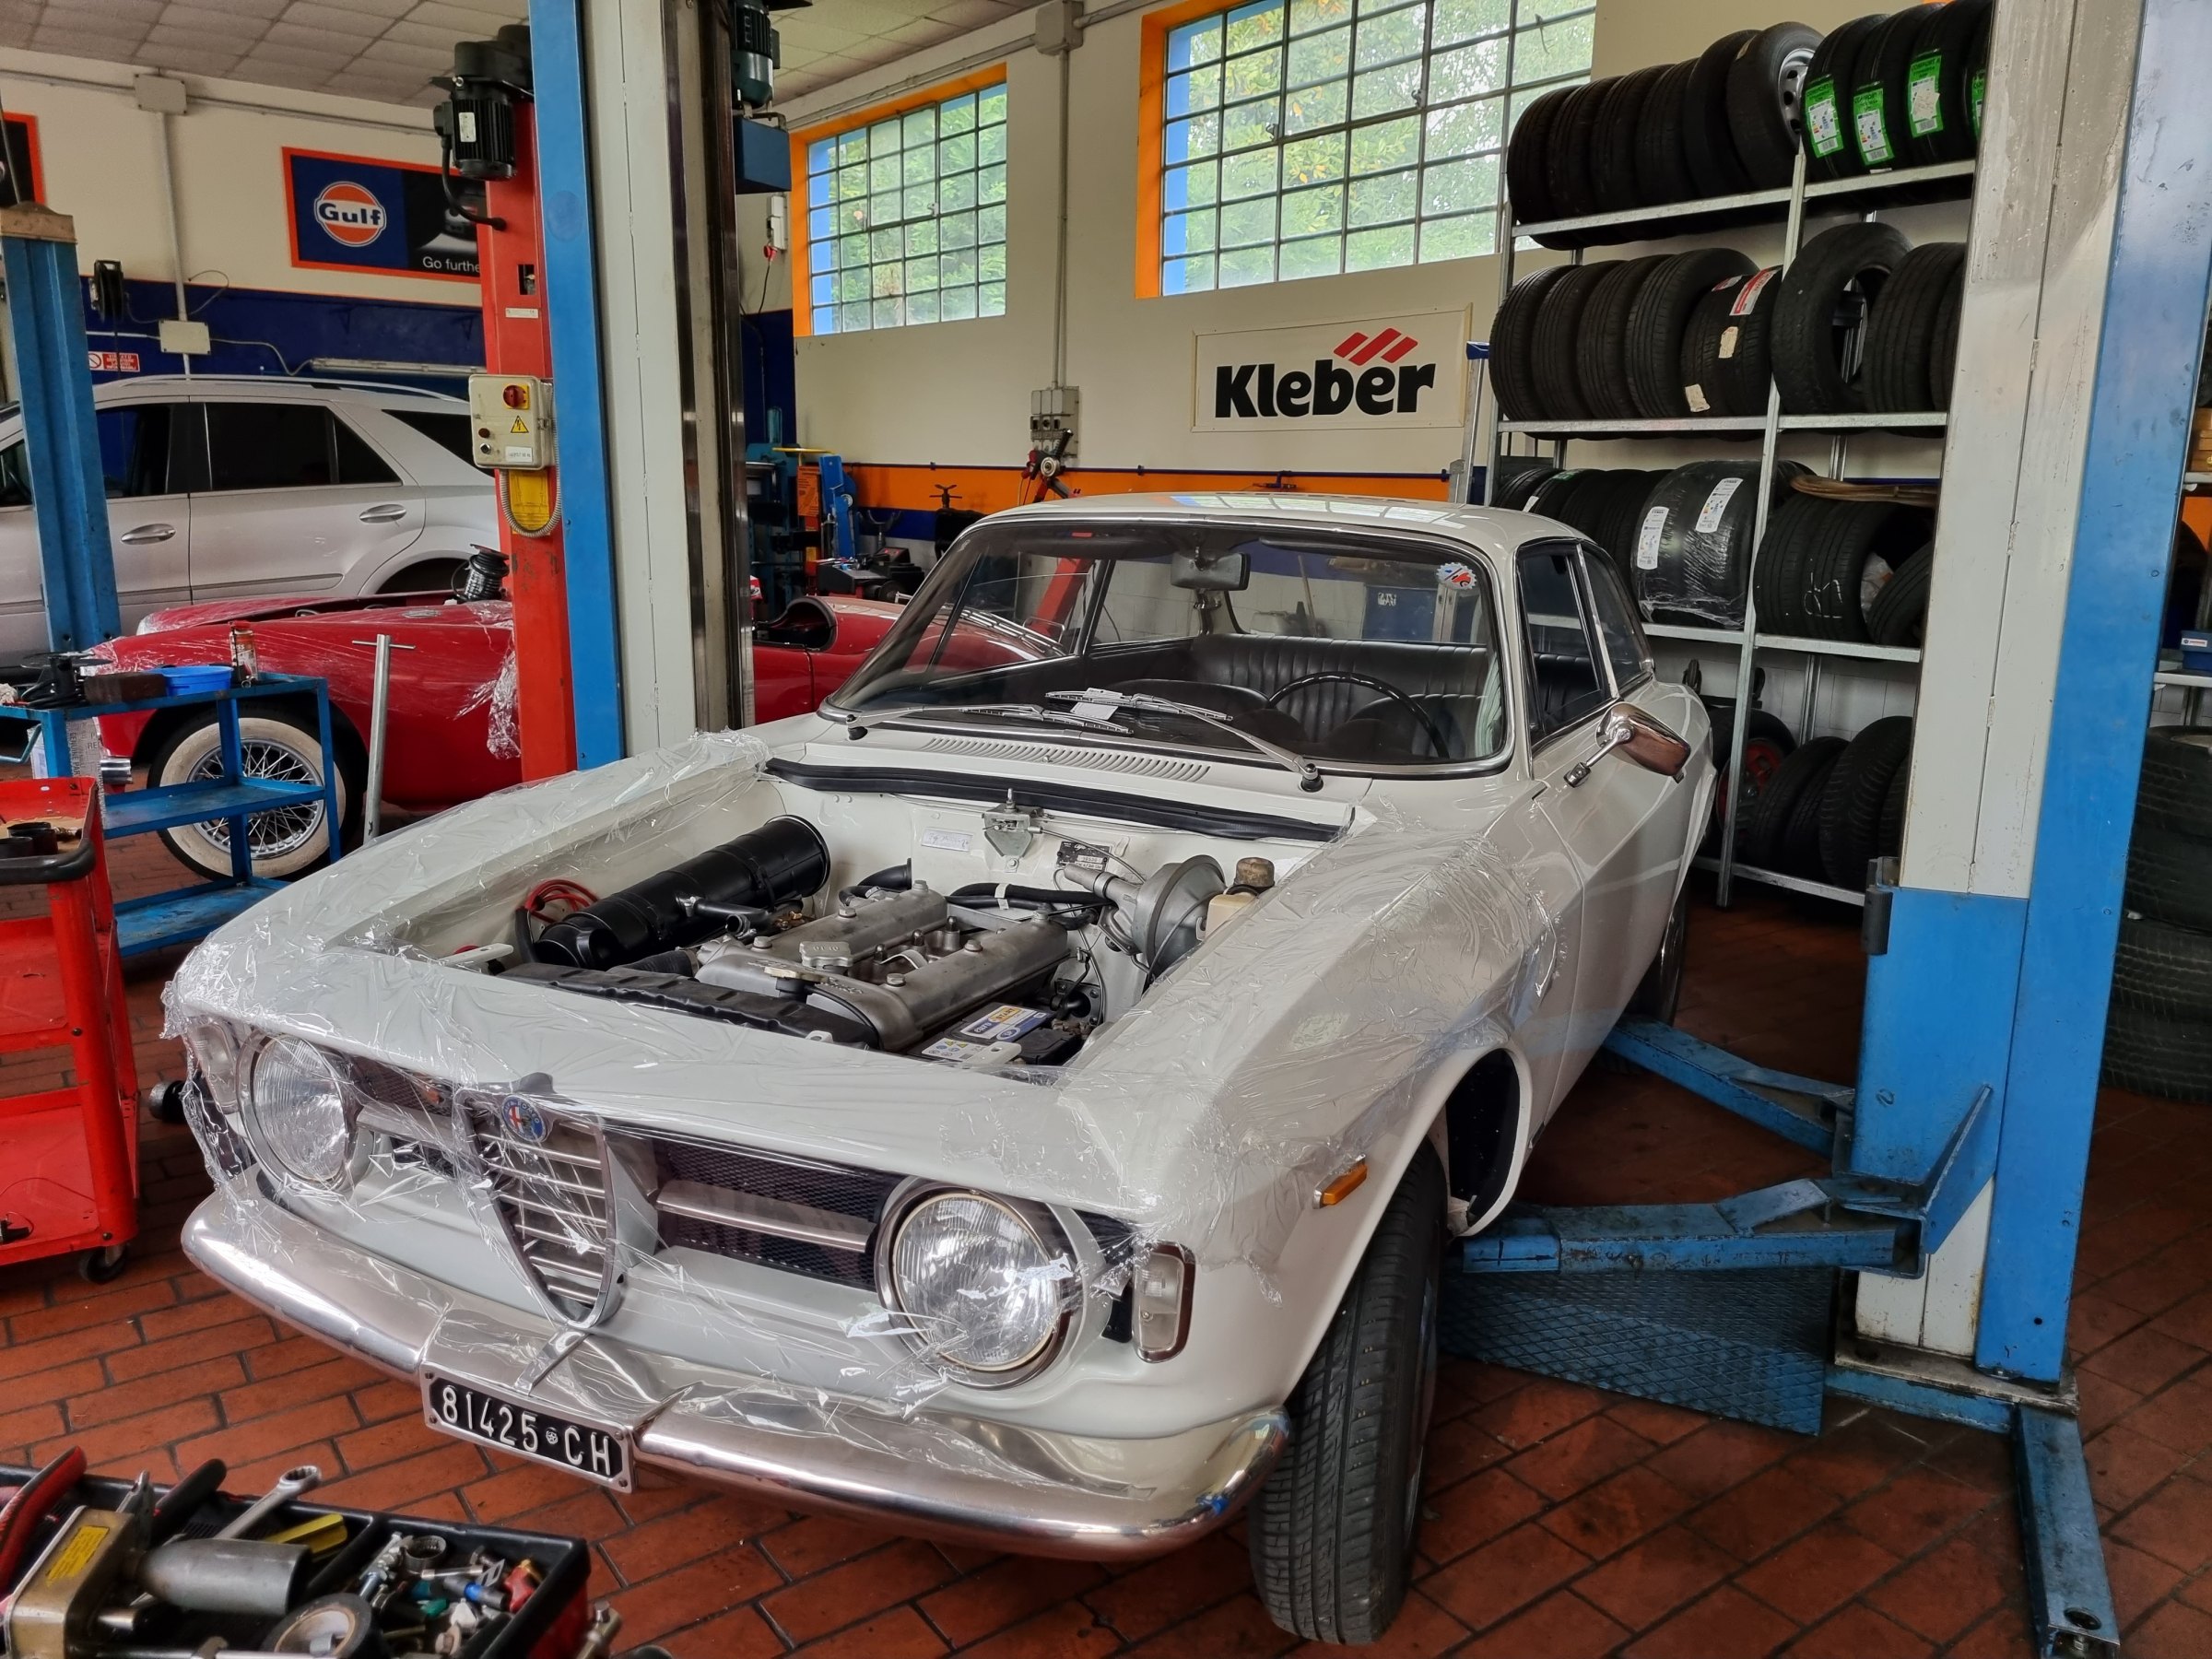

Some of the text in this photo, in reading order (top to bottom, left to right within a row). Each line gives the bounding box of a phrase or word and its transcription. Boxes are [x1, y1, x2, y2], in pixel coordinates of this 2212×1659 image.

[318, 202, 382, 227] Gulf
[422, 255, 480, 273] Go furthe
[1215, 359, 1437, 418] Kleber
[442, 1385, 611, 1476] 81425 CH
